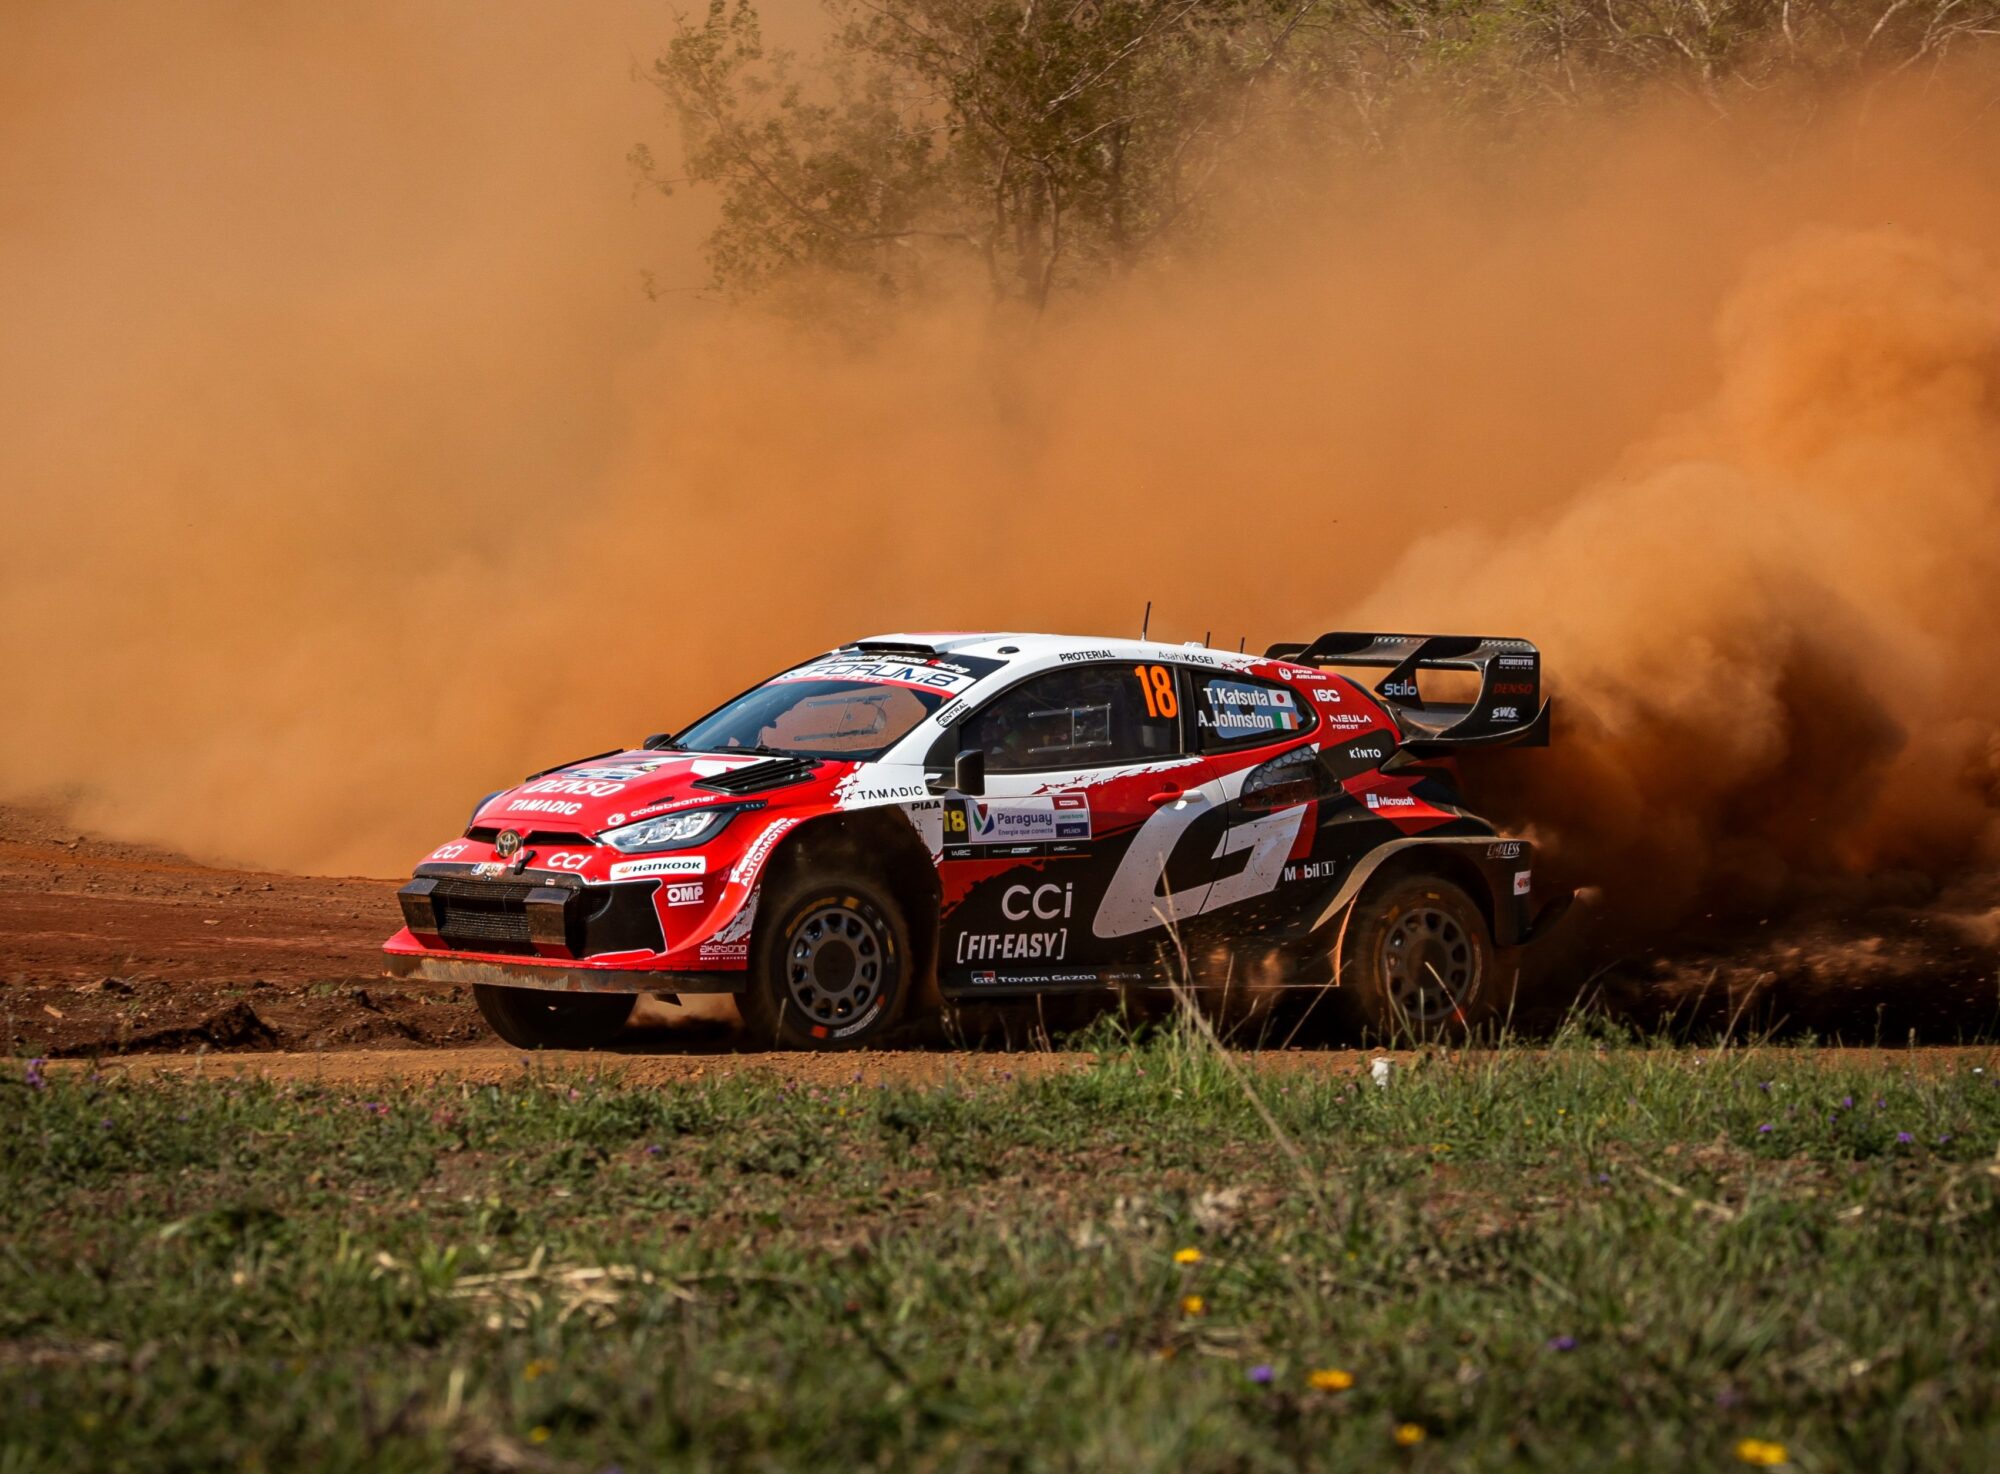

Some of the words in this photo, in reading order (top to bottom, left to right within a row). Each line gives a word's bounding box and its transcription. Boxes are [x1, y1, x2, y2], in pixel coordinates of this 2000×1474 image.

[1059, 650, 1115, 662] PROTERIAL
[804, 664, 960, 687] FORUM8
[1134, 665, 1178, 718] 18
[1203, 687, 1270, 707] T.Katsuta
[1384, 679, 1417, 697] Stilo
[1493, 682, 1534, 695] DENSO
[937, 702, 969, 727] CENTRAL
[1198, 709, 1274, 729] A.Johnston
[522, 779, 625, 797] DENSO
[858, 785, 924, 800] TAMADIC
[506, 799, 583, 816] TAMADIC
[630, 795, 718, 817] codebeamer
[911, 801, 941, 811] PIAA
[1378, 796, 1415, 807] Microsoft
[943, 810, 966, 832] 18
[997, 812, 1052, 827] Paraguay
[729, 817, 788, 883] Panasonic
[740, 817, 800, 887] AUTOMOTIVE
[1486, 842, 1520, 857] ENDLESS
[1284, 863, 1320, 881] Mobil
[667, 885, 704, 902] OMP
[700, 944, 747, 953] akebono
